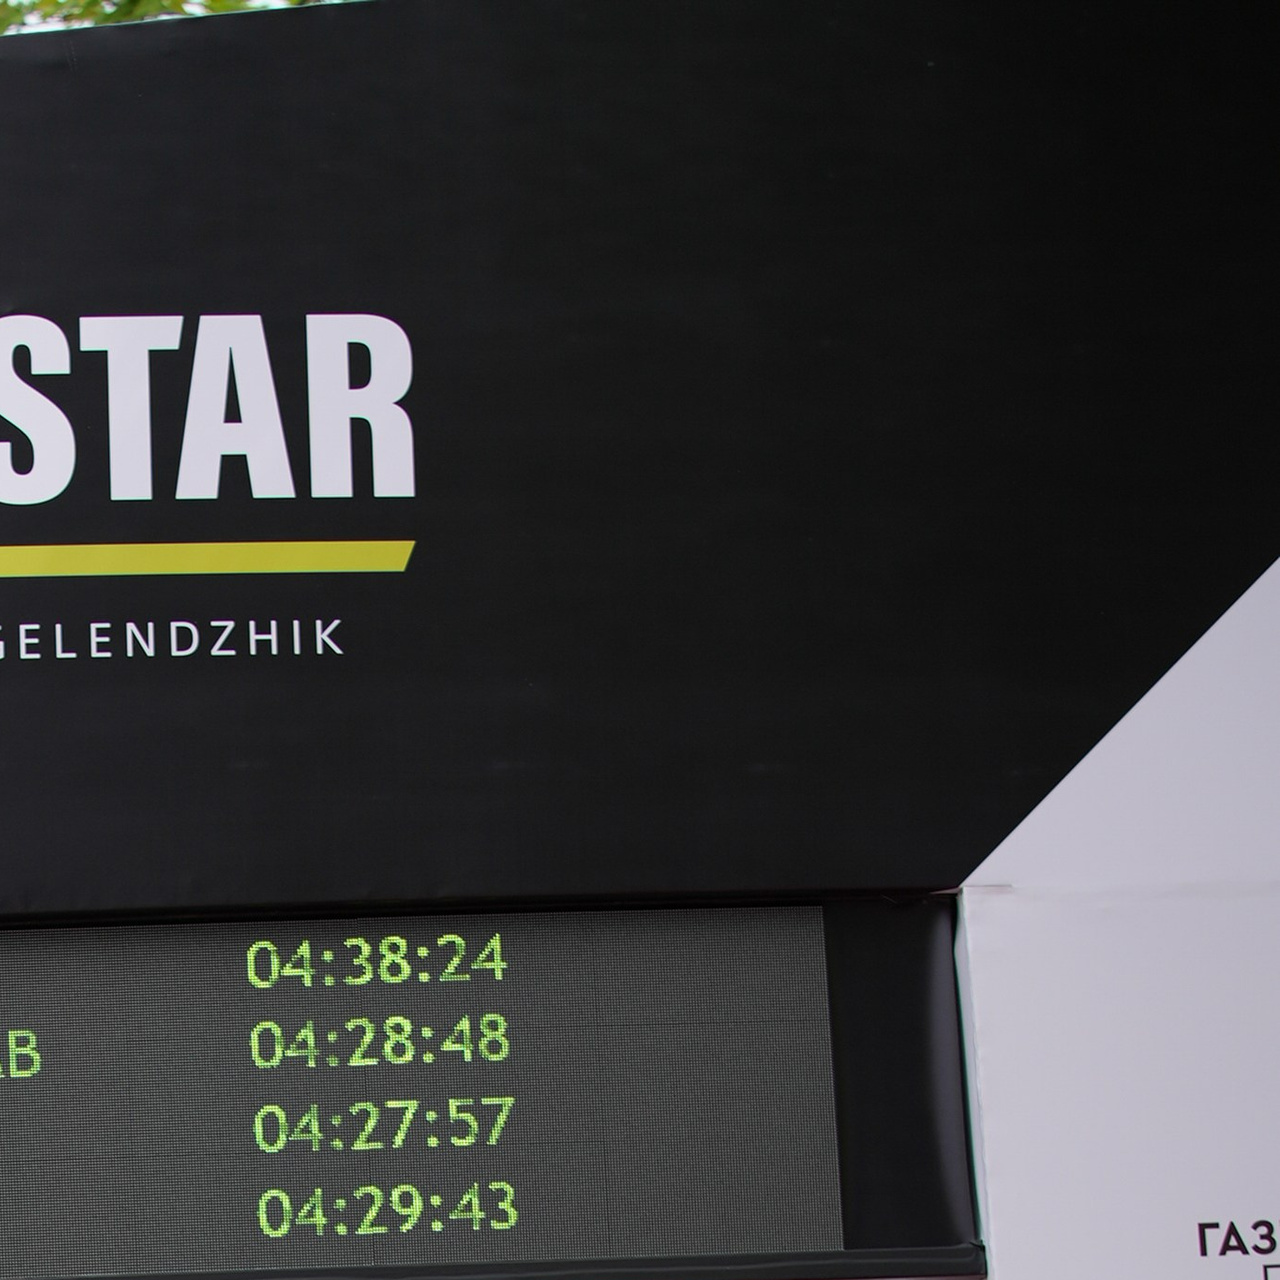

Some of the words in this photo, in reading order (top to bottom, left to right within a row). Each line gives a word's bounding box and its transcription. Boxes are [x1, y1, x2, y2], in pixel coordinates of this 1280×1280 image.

[245, 931, 508, 990] 04:38:24
[248, 1011, 511, 1070] 04:28:48
[251, 1095, 517, 1154] 04:27:57
[256, 1179, 520, 1239] 04:29:43
